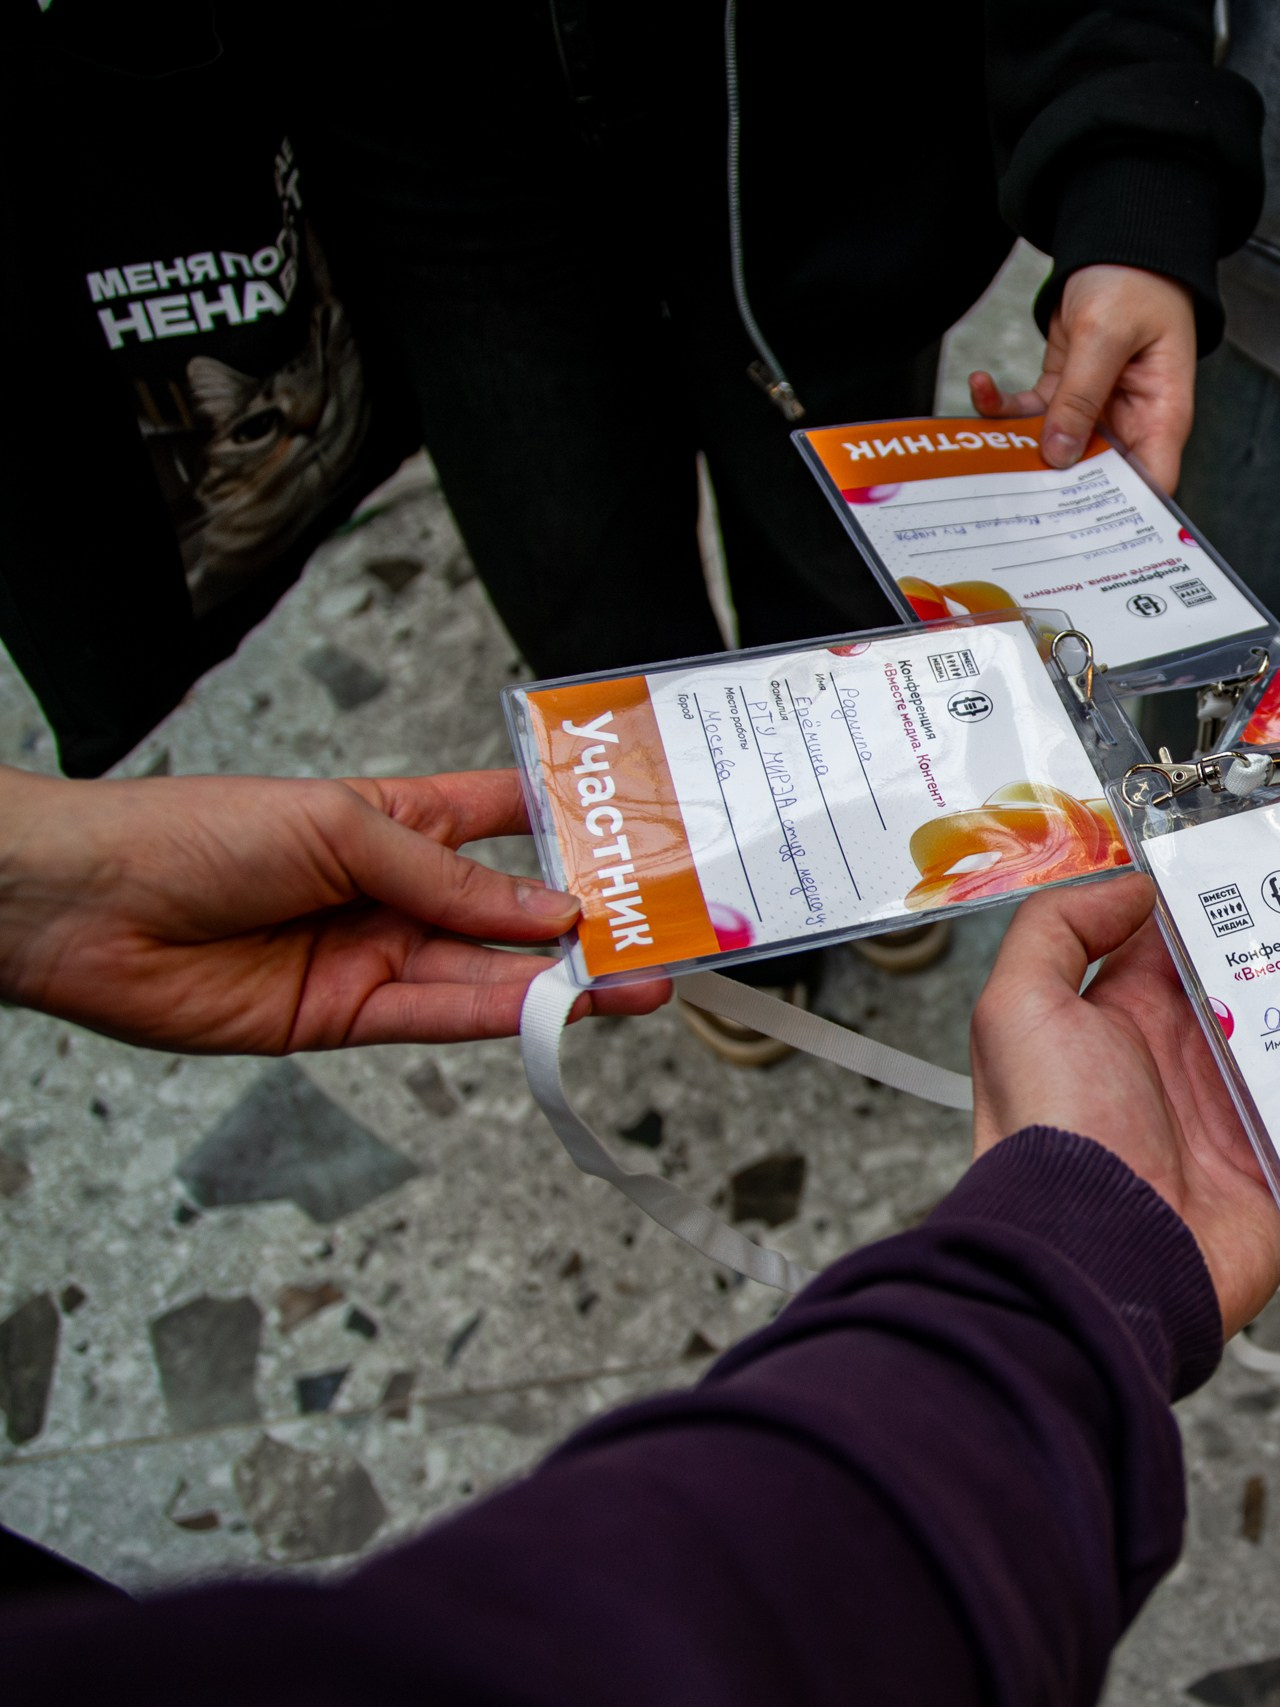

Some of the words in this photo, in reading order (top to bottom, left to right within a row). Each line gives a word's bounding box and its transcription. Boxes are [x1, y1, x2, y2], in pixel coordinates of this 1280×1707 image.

[86, 251, 220, 303] МЕНЯ
[839, 431, 1041, 461] частник
[1098, 563, 1191, 592] Конференция
[1127, 556, 1184, 575] «Вместе
[1021, 582, 1084, 600] Контент»
[931, 657, 945, 679] МЕДИА
[960, 651, 976, 674] ВМЕСТЕ
[813, 672, 829, 691] Имя
[676, 693, 694, 720] Город
[722, 686, 740, 715] Место
[768, 679, 789, 721] Фамилия
[896, 659, 936, 740] Конференция
[729, 715, 751, 750] работы
[746, 700, 777, 737] РТУ
[702, 707, 735, 783] Москва
[881, 662, 908, 711] «Вместе
[898, 712, 923, 752] медиа.
[915, 753, 946, 809] Контент»
[760, 748, 799, 809] МИРЭА
[560, 710, 654, 951] Участник
[1202, 887, 1237, 903] ВМЕСТЕ
[1216, 918, 1249, 933] МЕДИА
